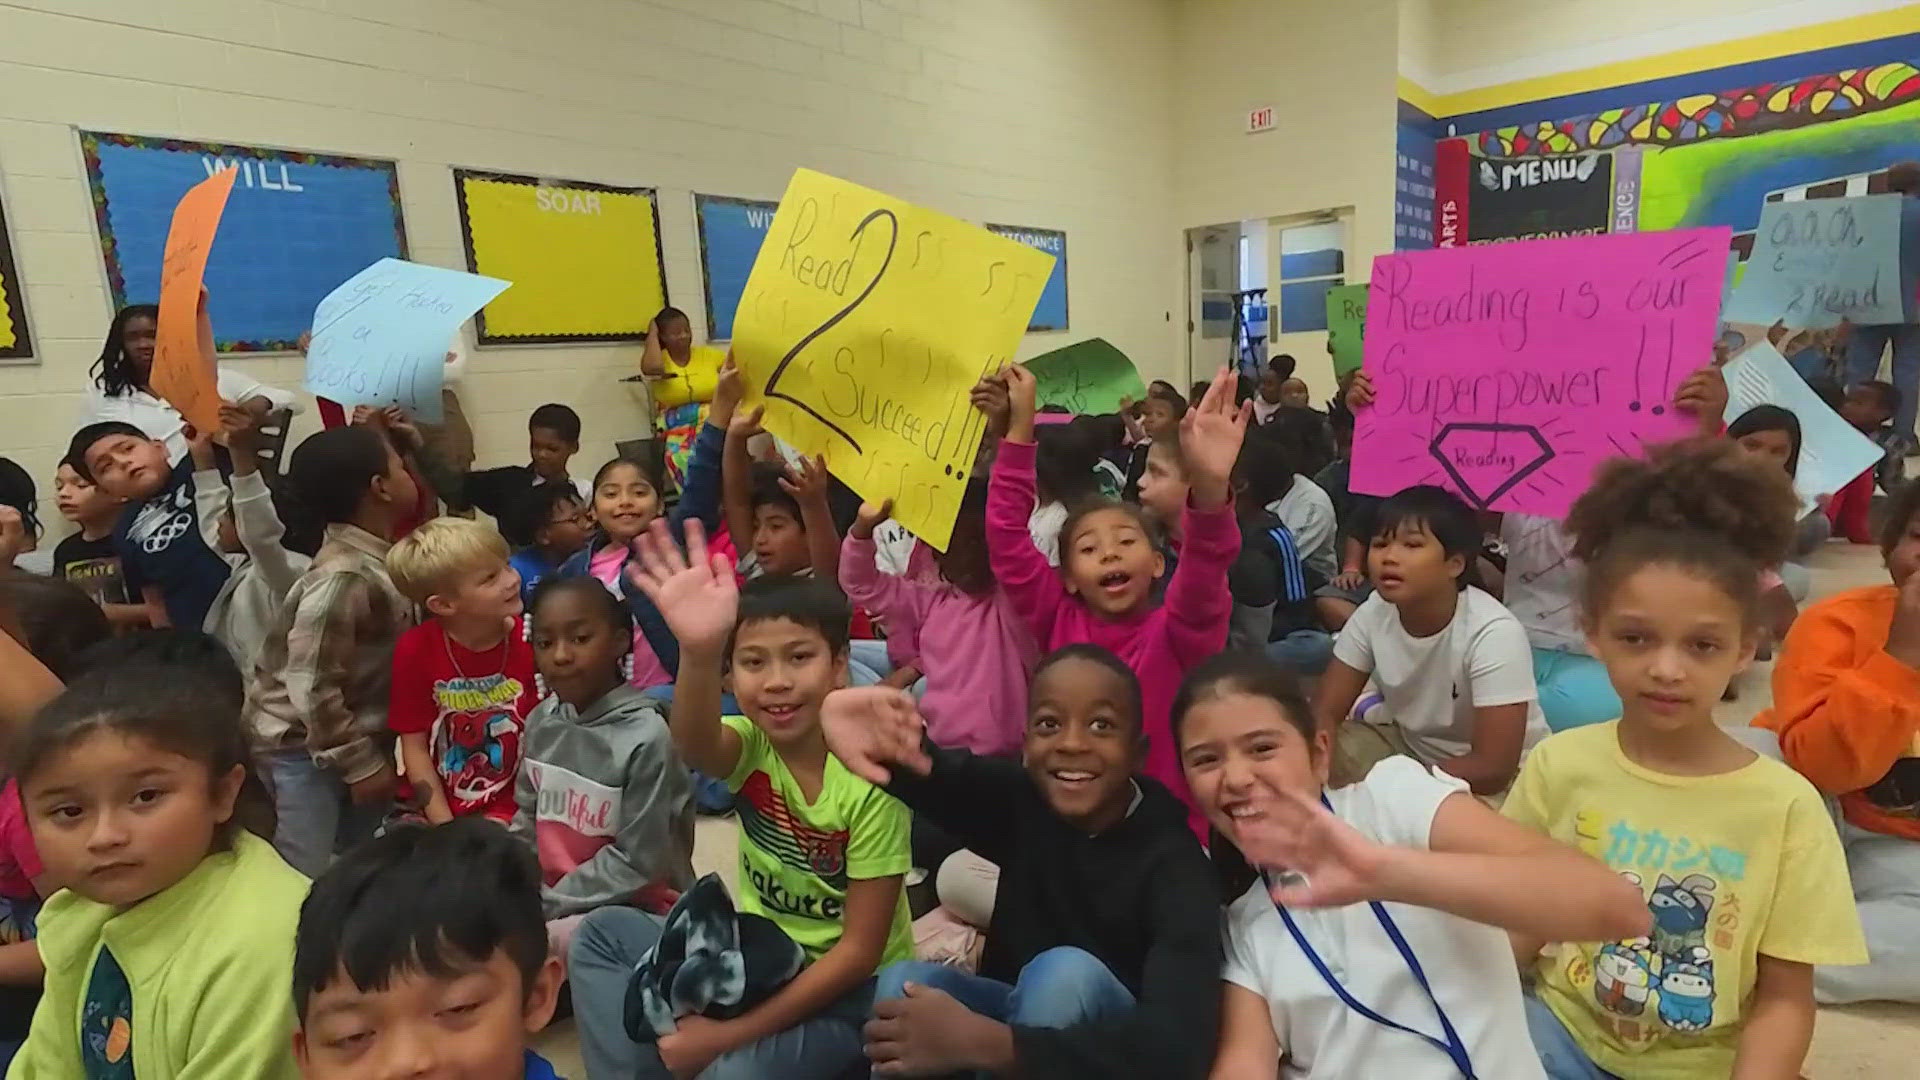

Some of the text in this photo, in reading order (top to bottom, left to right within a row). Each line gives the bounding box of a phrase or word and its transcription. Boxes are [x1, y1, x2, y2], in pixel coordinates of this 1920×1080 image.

[1251, 109, 1271, 129] EXIT
[202, 157, 303, 192] WILL
[1502, 159, 1577, 191] MENU
[536, 188, 601, 216] SOAR
[1440, 200, 1458, 248] ARTS
[780, 197, 864, 297] Read
[1384, 260, 1530, 352] Reading
[1558, 279, 1600, 320] is
[1625, 275, 1701, 313] our
[764, 208, 898, 455] 2
